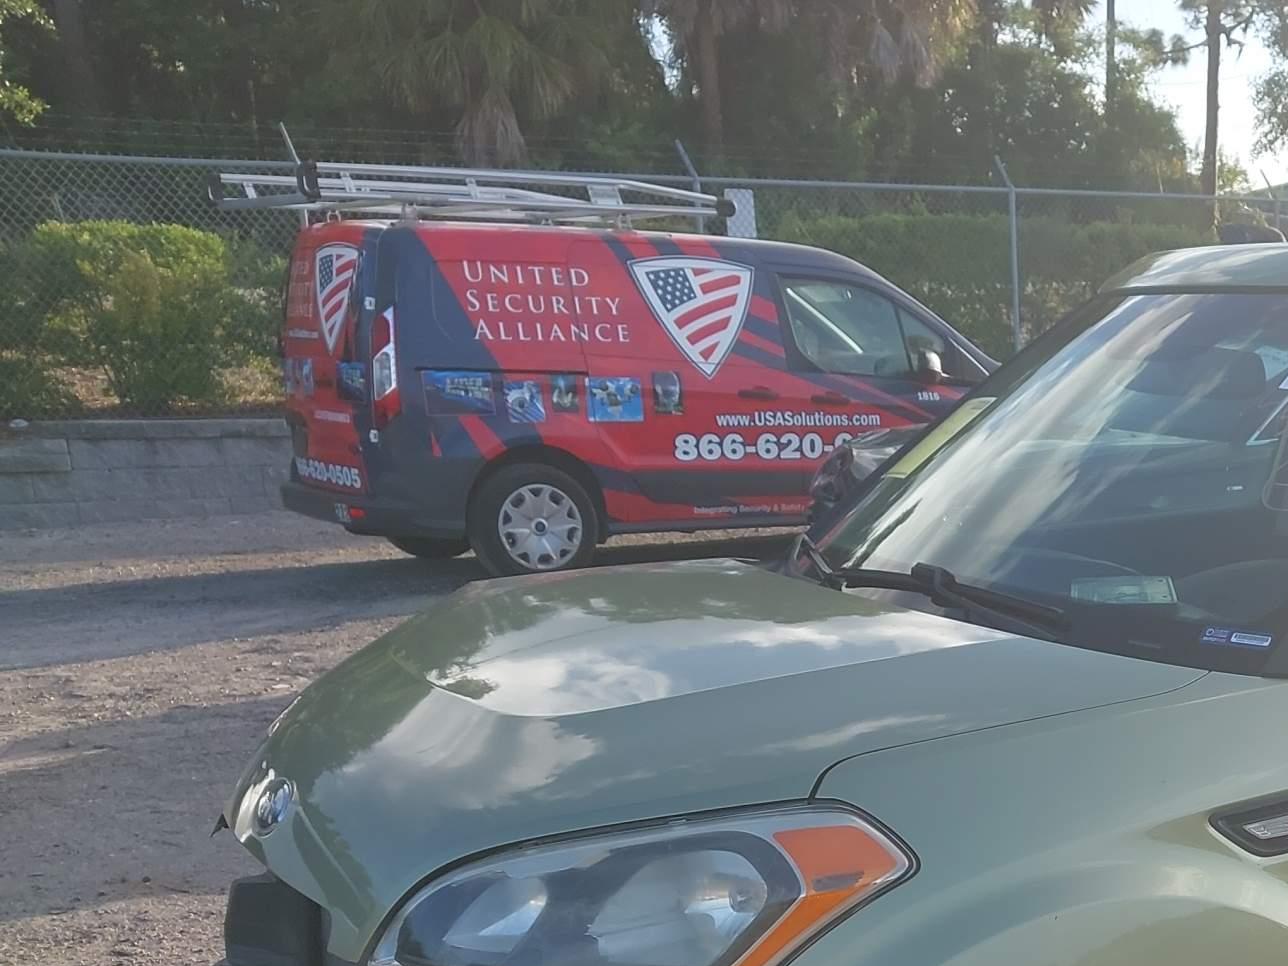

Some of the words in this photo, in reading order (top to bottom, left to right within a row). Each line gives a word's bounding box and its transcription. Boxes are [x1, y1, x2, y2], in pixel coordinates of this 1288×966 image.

[462, 260, 589, 287] UNITED
[465, 289, 621, 316] SECURITY
[473, 318, 631, 343] ALLIANCE
[716, 411, 881, 428] www.USASolutions.com
